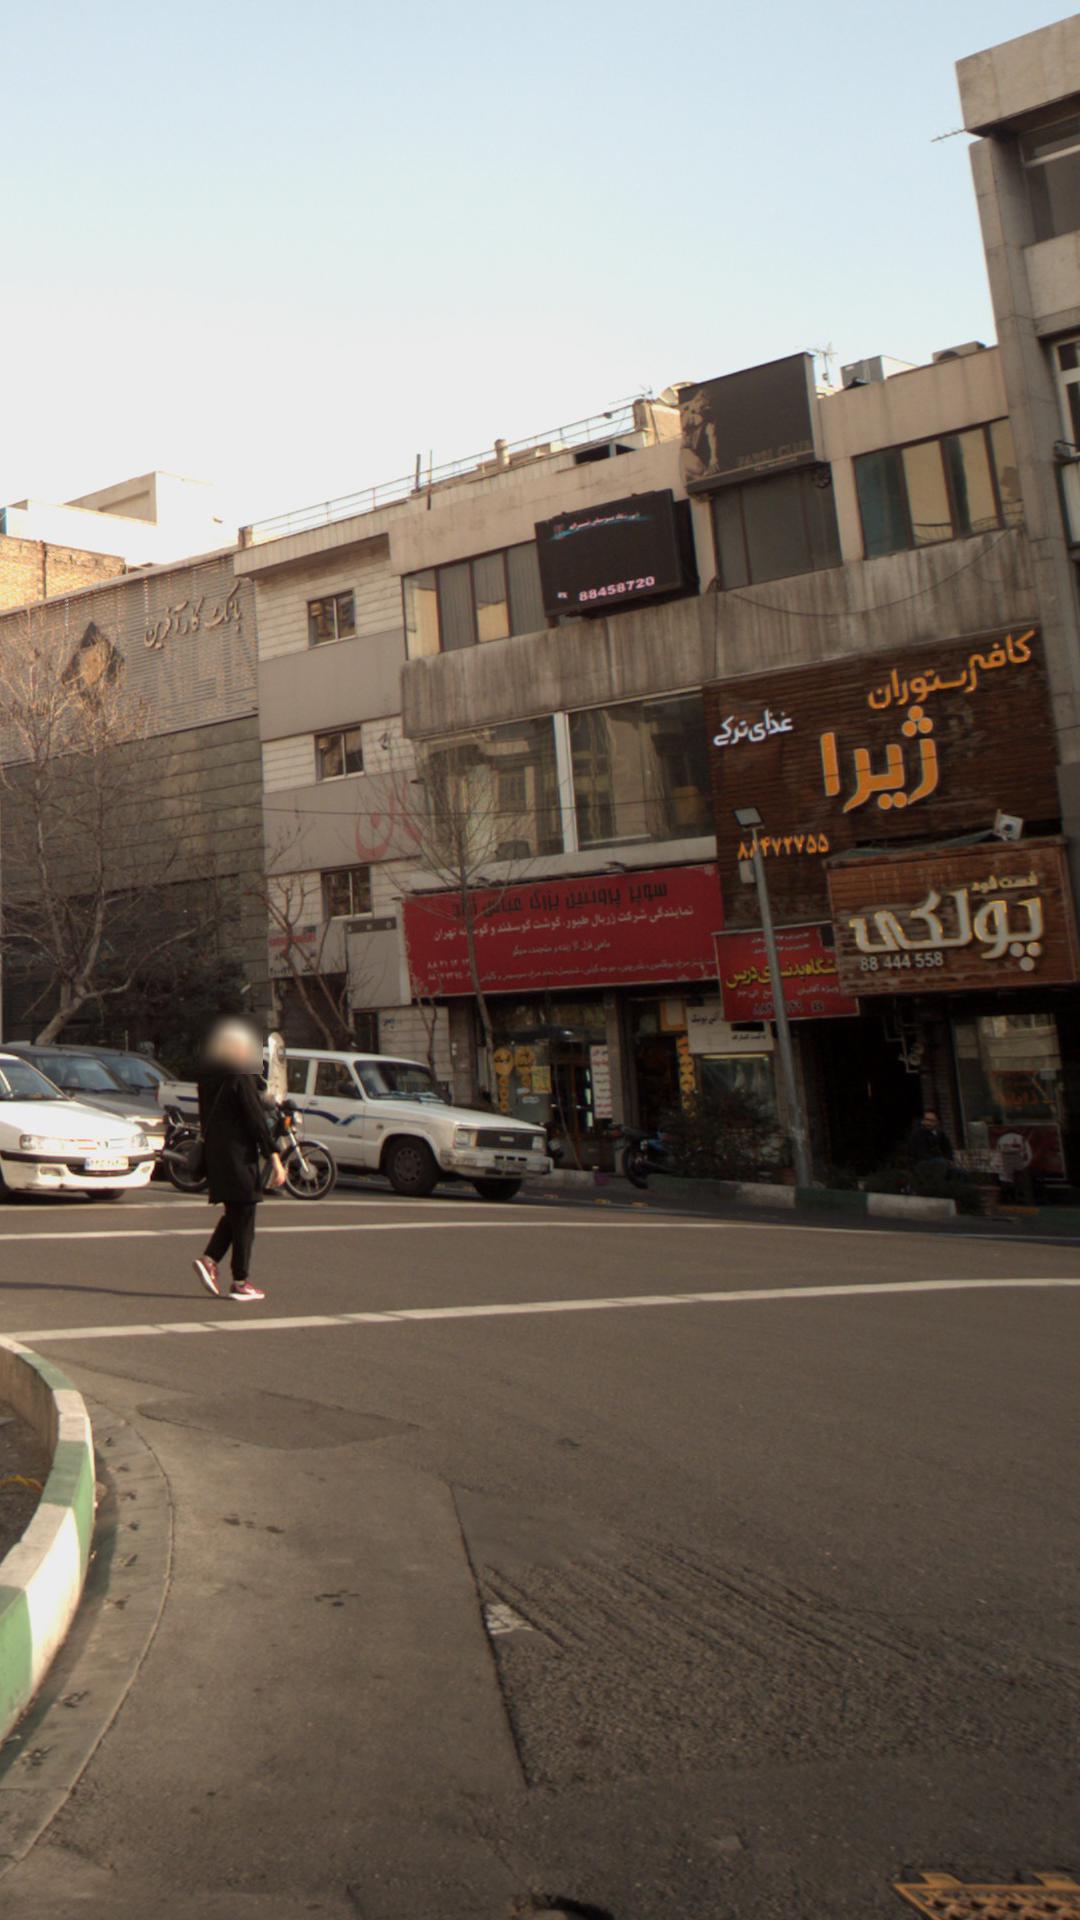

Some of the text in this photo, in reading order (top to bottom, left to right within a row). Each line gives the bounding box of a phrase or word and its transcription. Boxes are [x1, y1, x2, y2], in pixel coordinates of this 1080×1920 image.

[578, 576, 656, 601] 88458720
[867, 629, 1037, 709] کافه رستوران
[748, 708, 795, 743] غذای
[820, 704, 940, 814] ژیرا
[628, 881, 667, 904] سوپر
[533, 916, 561, 932] گوشت
[617, 908, 648, 925] شرکت
[649, 904, 695, 924] نمایندگی
[432, 927, 457, 942] تهران
[490, 926, 497, 937] و
[848, 887, 1044, 972] پولکی
[860, 950, 945, 972] 88 444 558
